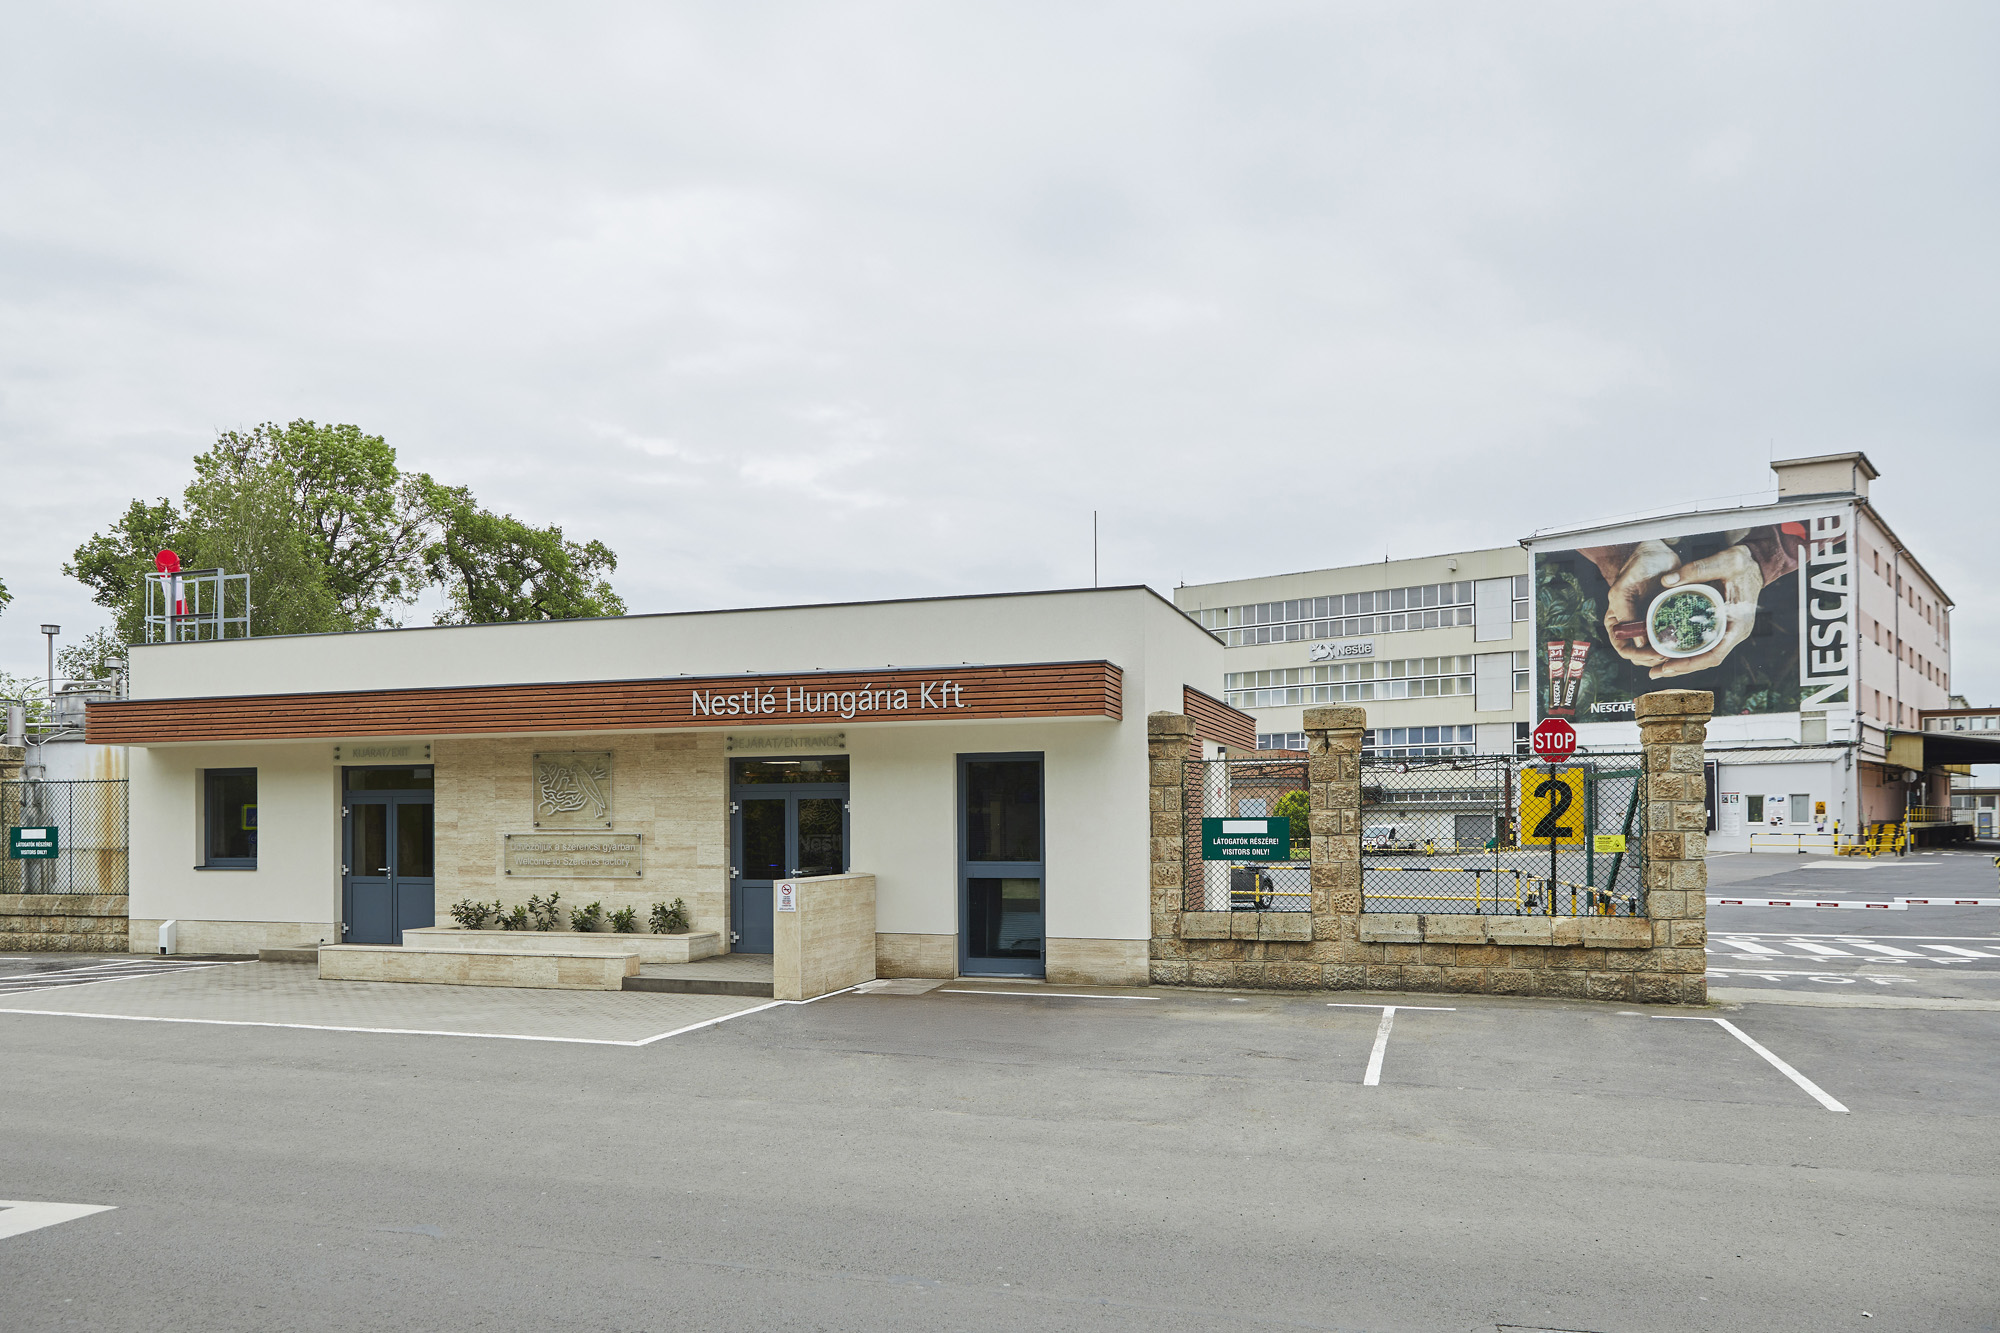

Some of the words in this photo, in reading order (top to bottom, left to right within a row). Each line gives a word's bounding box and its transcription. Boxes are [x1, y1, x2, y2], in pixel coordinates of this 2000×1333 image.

[692, 686, 776, 716] Nestlé
[786, 682, 908, 719] Hungária
[1535, 732, 1574, 749] STOP
[1532, 780, 1573, 837] 2
[554, 843, 560, 851] a
[1213, 837, 1249, 845] LÁTOGATÓK
[1250, 837, 1279, 845] RÉSZÉRE!
[514, 855, 551, 865] Welcome
[562, 856, 600, 866] Szerencs
[602, 857, 630, 868] factory
